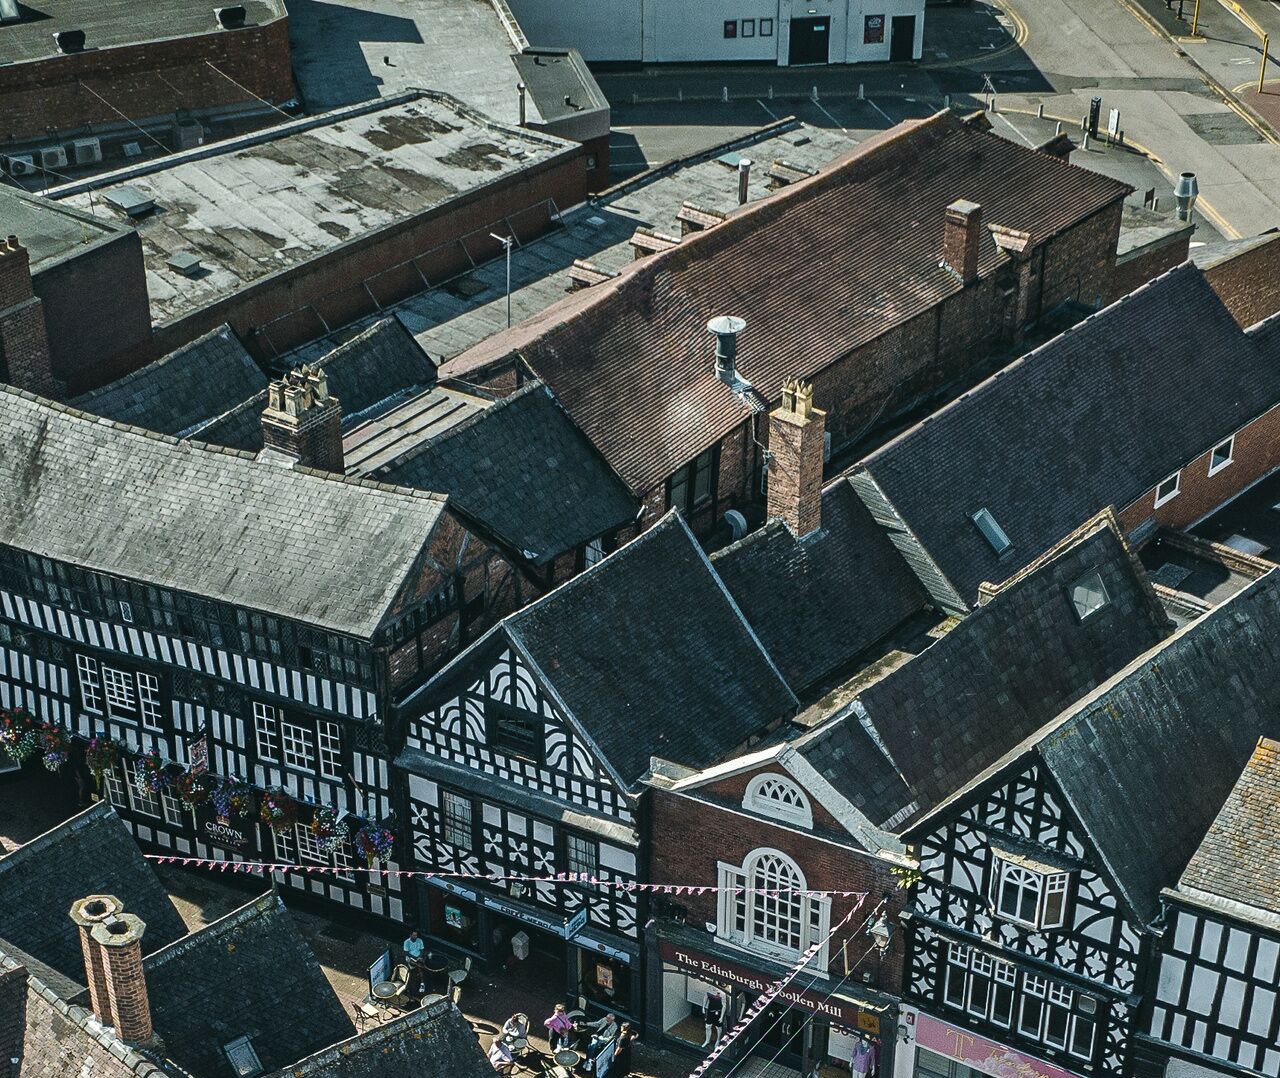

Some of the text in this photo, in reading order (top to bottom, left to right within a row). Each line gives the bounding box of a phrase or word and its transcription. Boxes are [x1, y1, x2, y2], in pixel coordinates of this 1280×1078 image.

[205, 821, 243, 840] CROWN
[676, 951, 699, 967] The
[701, 961, 764, 990] Edinburgh
[817, 1001, 842, 1018] Mill
[945, 1028, 976, 1060] T
